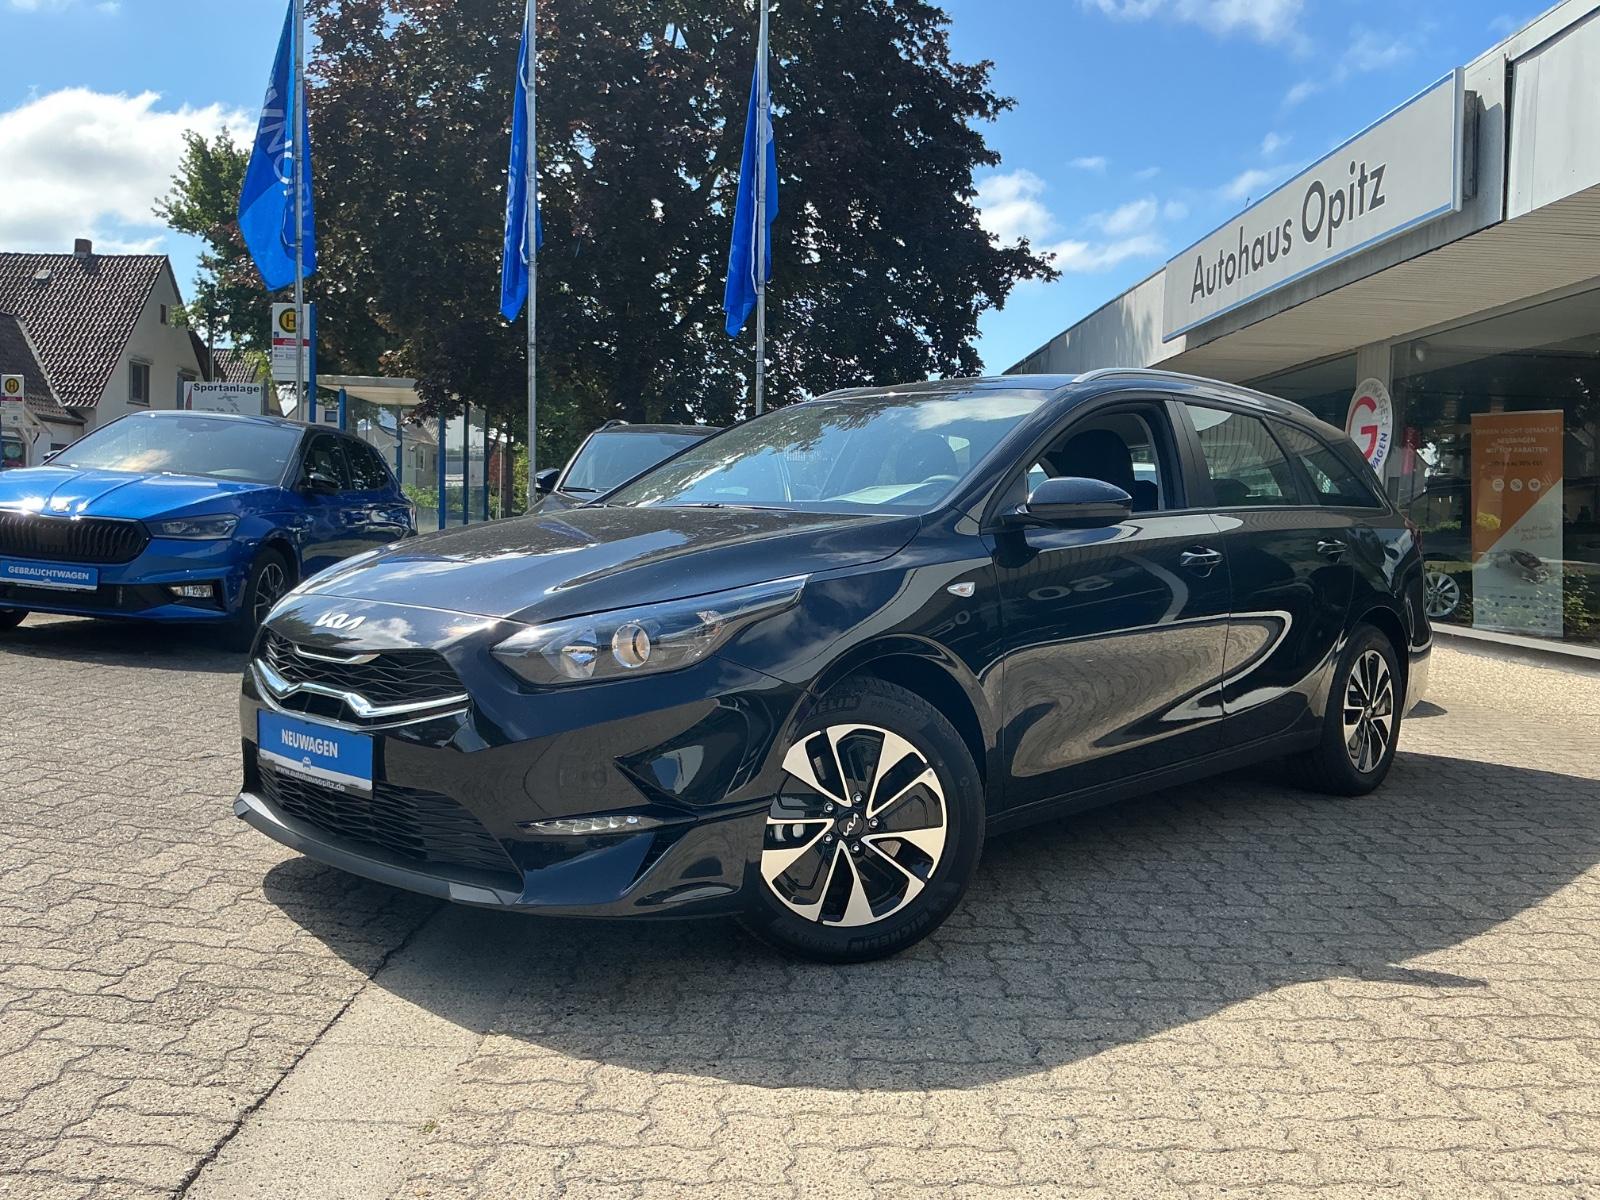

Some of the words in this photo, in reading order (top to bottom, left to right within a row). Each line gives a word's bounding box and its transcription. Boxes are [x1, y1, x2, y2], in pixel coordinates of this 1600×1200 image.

[1190, 218, 1293, 304] Autohaus
[1301, 160, 1387, 249] Opitz
[193, 382, 260, 395] Sportanlage
[8, 565, 89, 580] GEBRAUCHTWAGEN
[281, 728, 339, 759] NEUWAGEN
